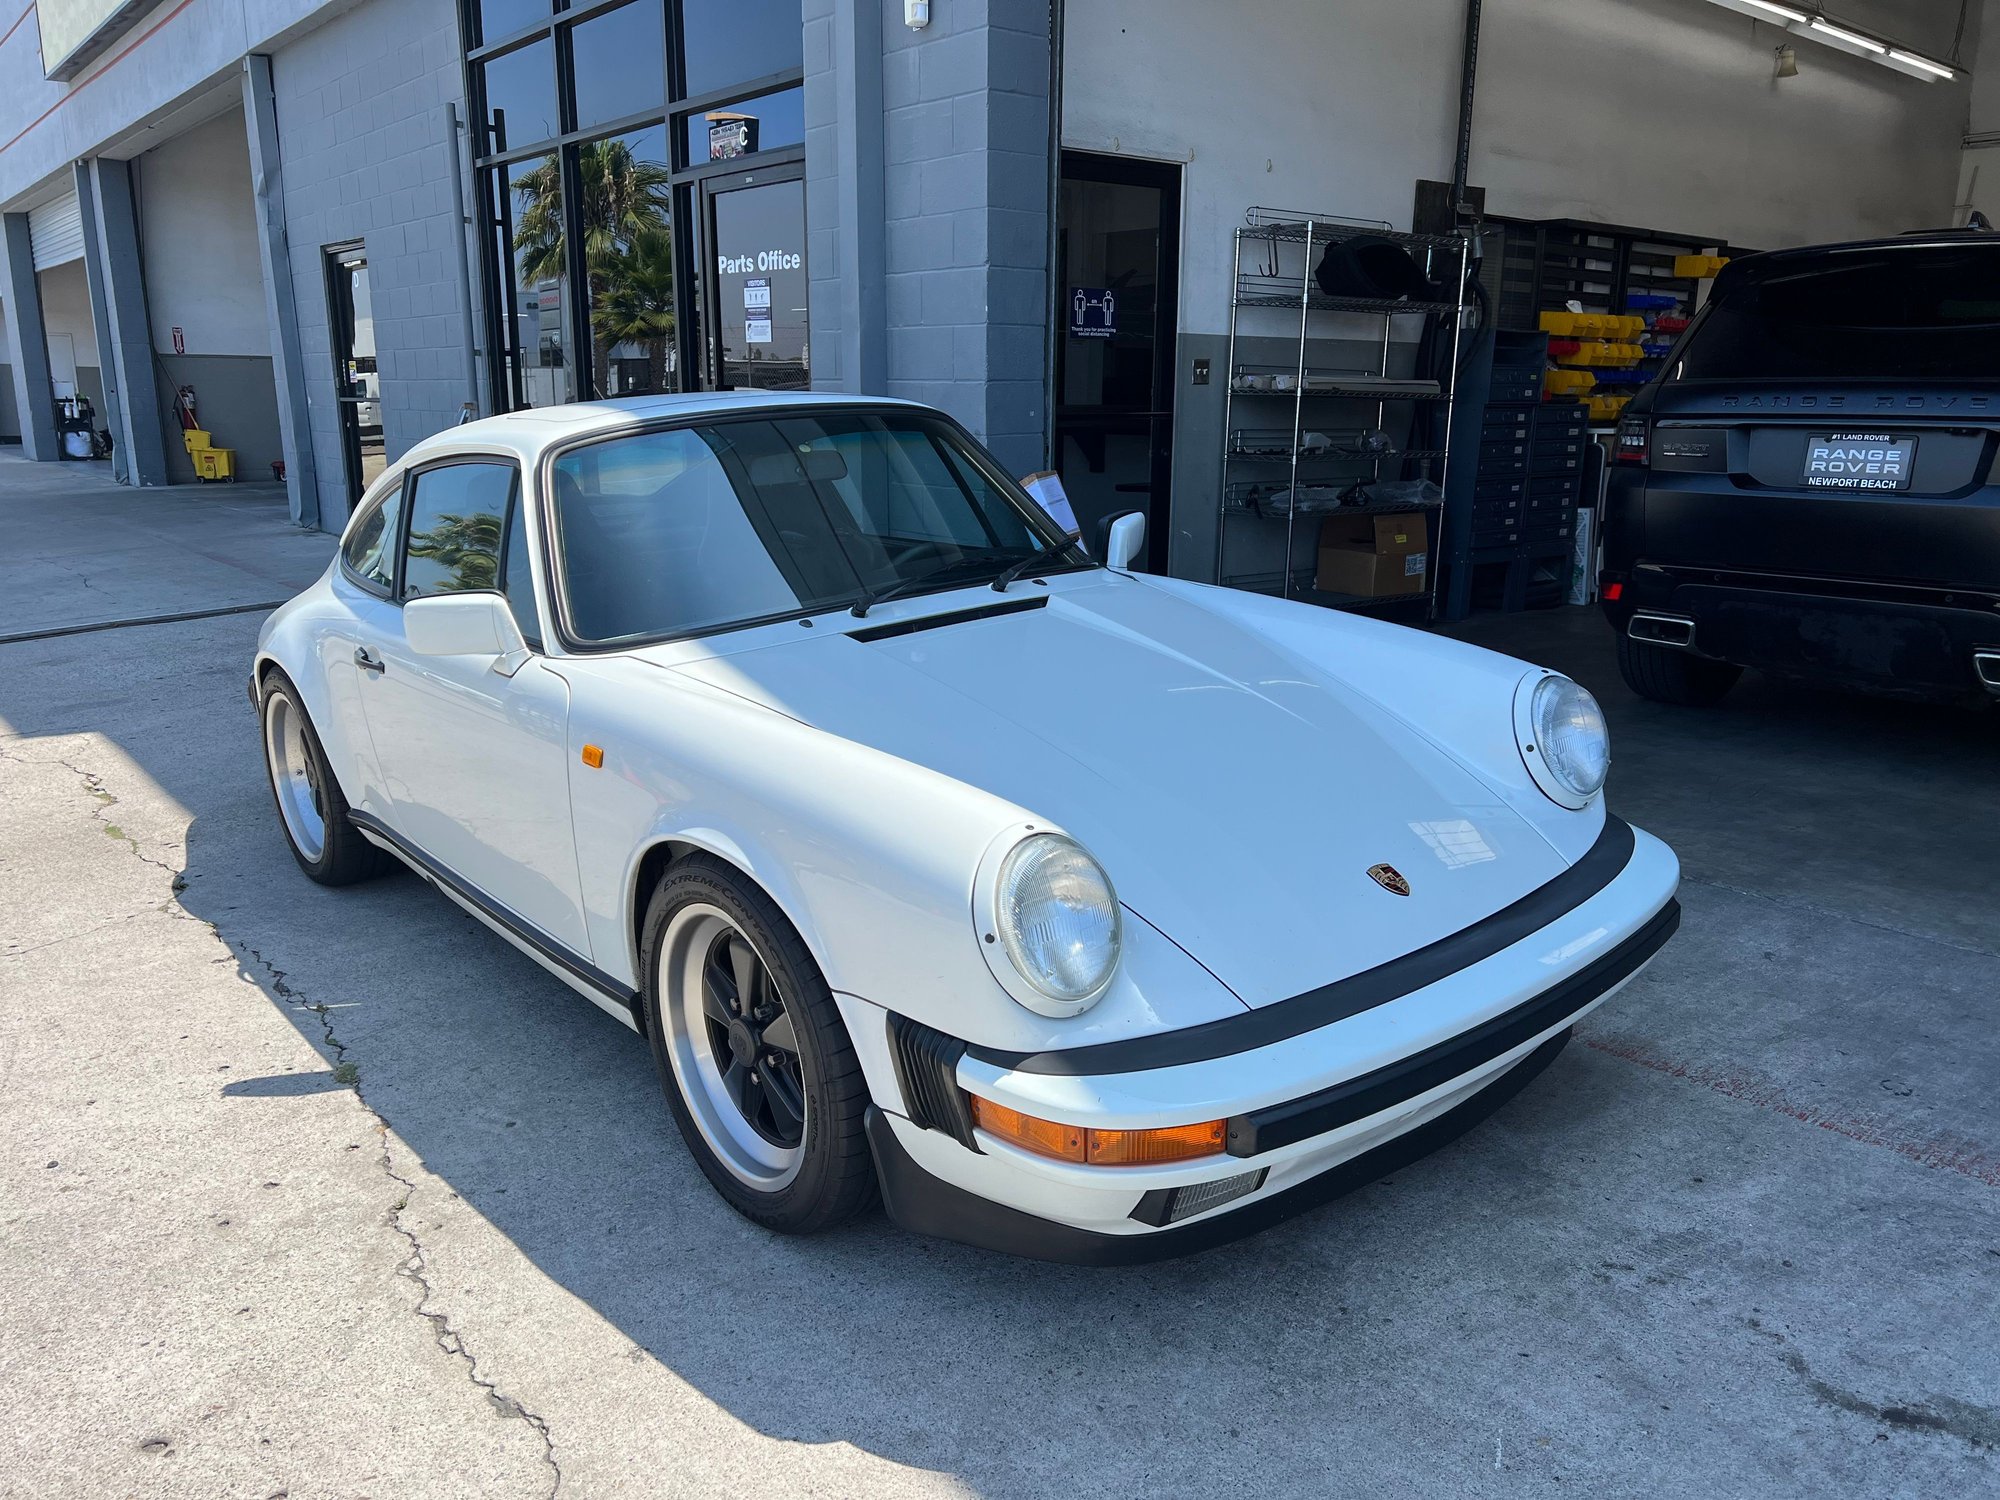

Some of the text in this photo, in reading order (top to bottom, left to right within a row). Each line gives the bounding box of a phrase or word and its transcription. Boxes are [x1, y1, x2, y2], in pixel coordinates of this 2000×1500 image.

[718, 249, 801, 275] Parts Office
[1720, 395, 1846, 409] RANGE
[1864, 434, 1890, 442] ROVER
[1813, 448, 1902, 461] RANGE
[1810, 461, 1901, 474] ROVER
[1808, 476, 1897, 489] NEWPORT BEACH
